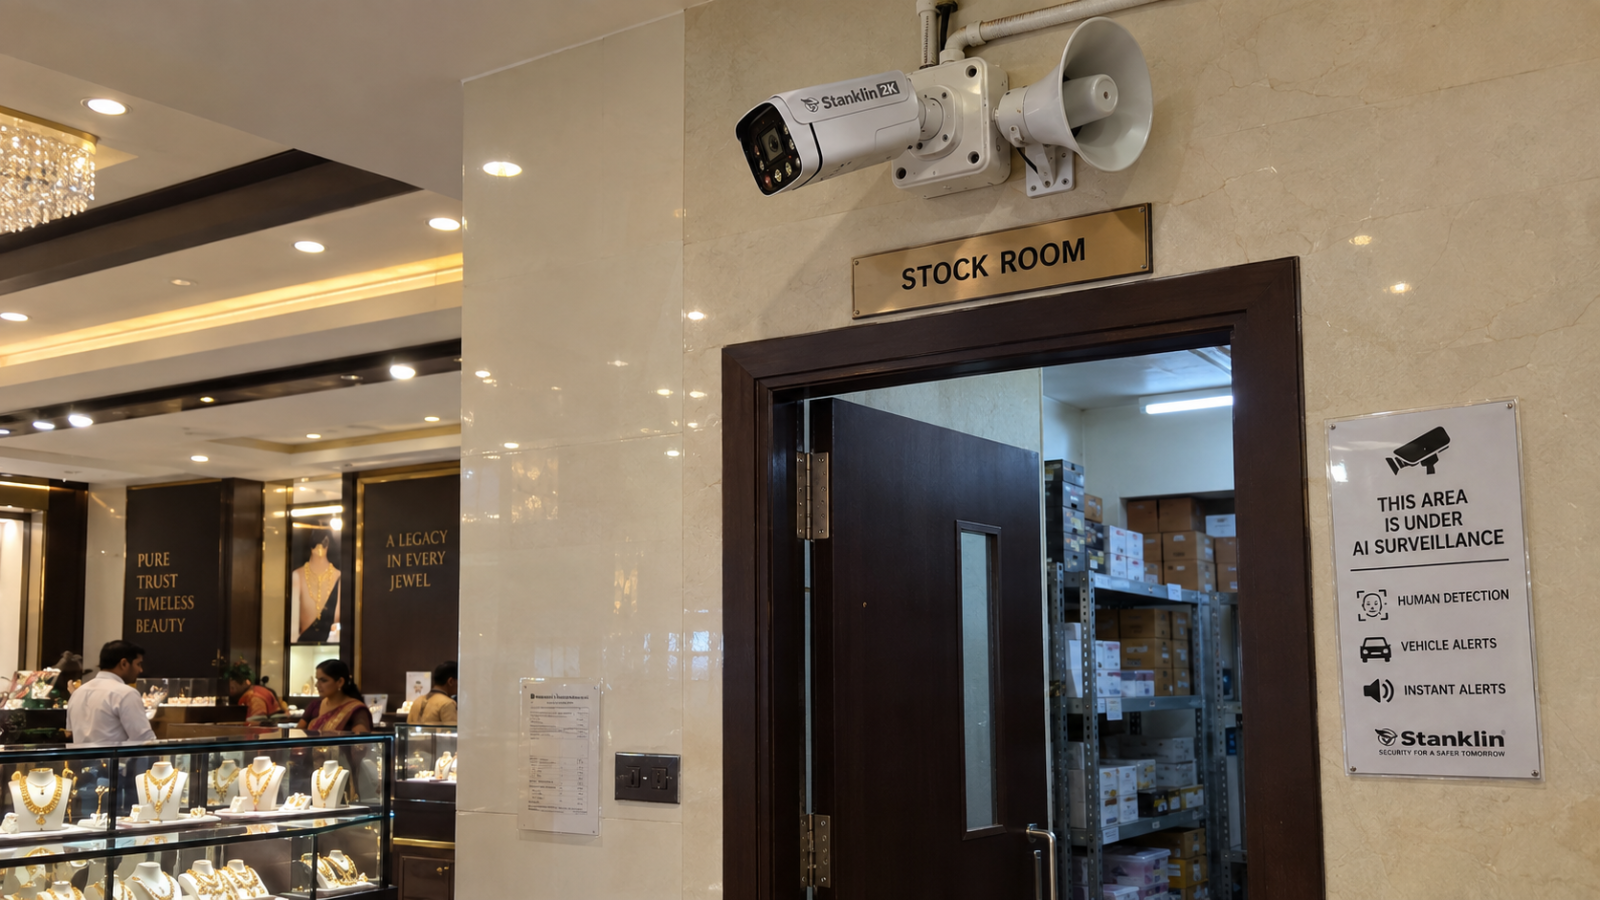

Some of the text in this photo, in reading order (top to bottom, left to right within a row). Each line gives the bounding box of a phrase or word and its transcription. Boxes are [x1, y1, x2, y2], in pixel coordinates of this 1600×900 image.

[821, 82, 898, 109] Stanklin 2K
[901, 237, 1086, 290] STOCK ROOM
[1377, 489, 1468, 512] THIS AREA
[1385, 511, 1463, 532] IS UNDER
[385, 530, 448, 548] A LEGACY
[1352, 529, 1504, 556] AI SURVEILLANCE
[137, 552, 170, 568] PURE
[387, 551, 446, 568] IN EVERY
[136, 573, 178, 589] TRUST
[389, 572, 431, 592] JEWEL
[135, 595, 195, 612] TIMELESS
[1397, 589, 1510, 606] HUMAN DETECTION
[136, 618, 186, 633] BEAUTY
[1400, 637, 1497, 652] VEHICLE ALERTS
[1404, 683, 1506, 696] INSTANT ALERTS
[1401, 730, 1505, 747] Stanklin
